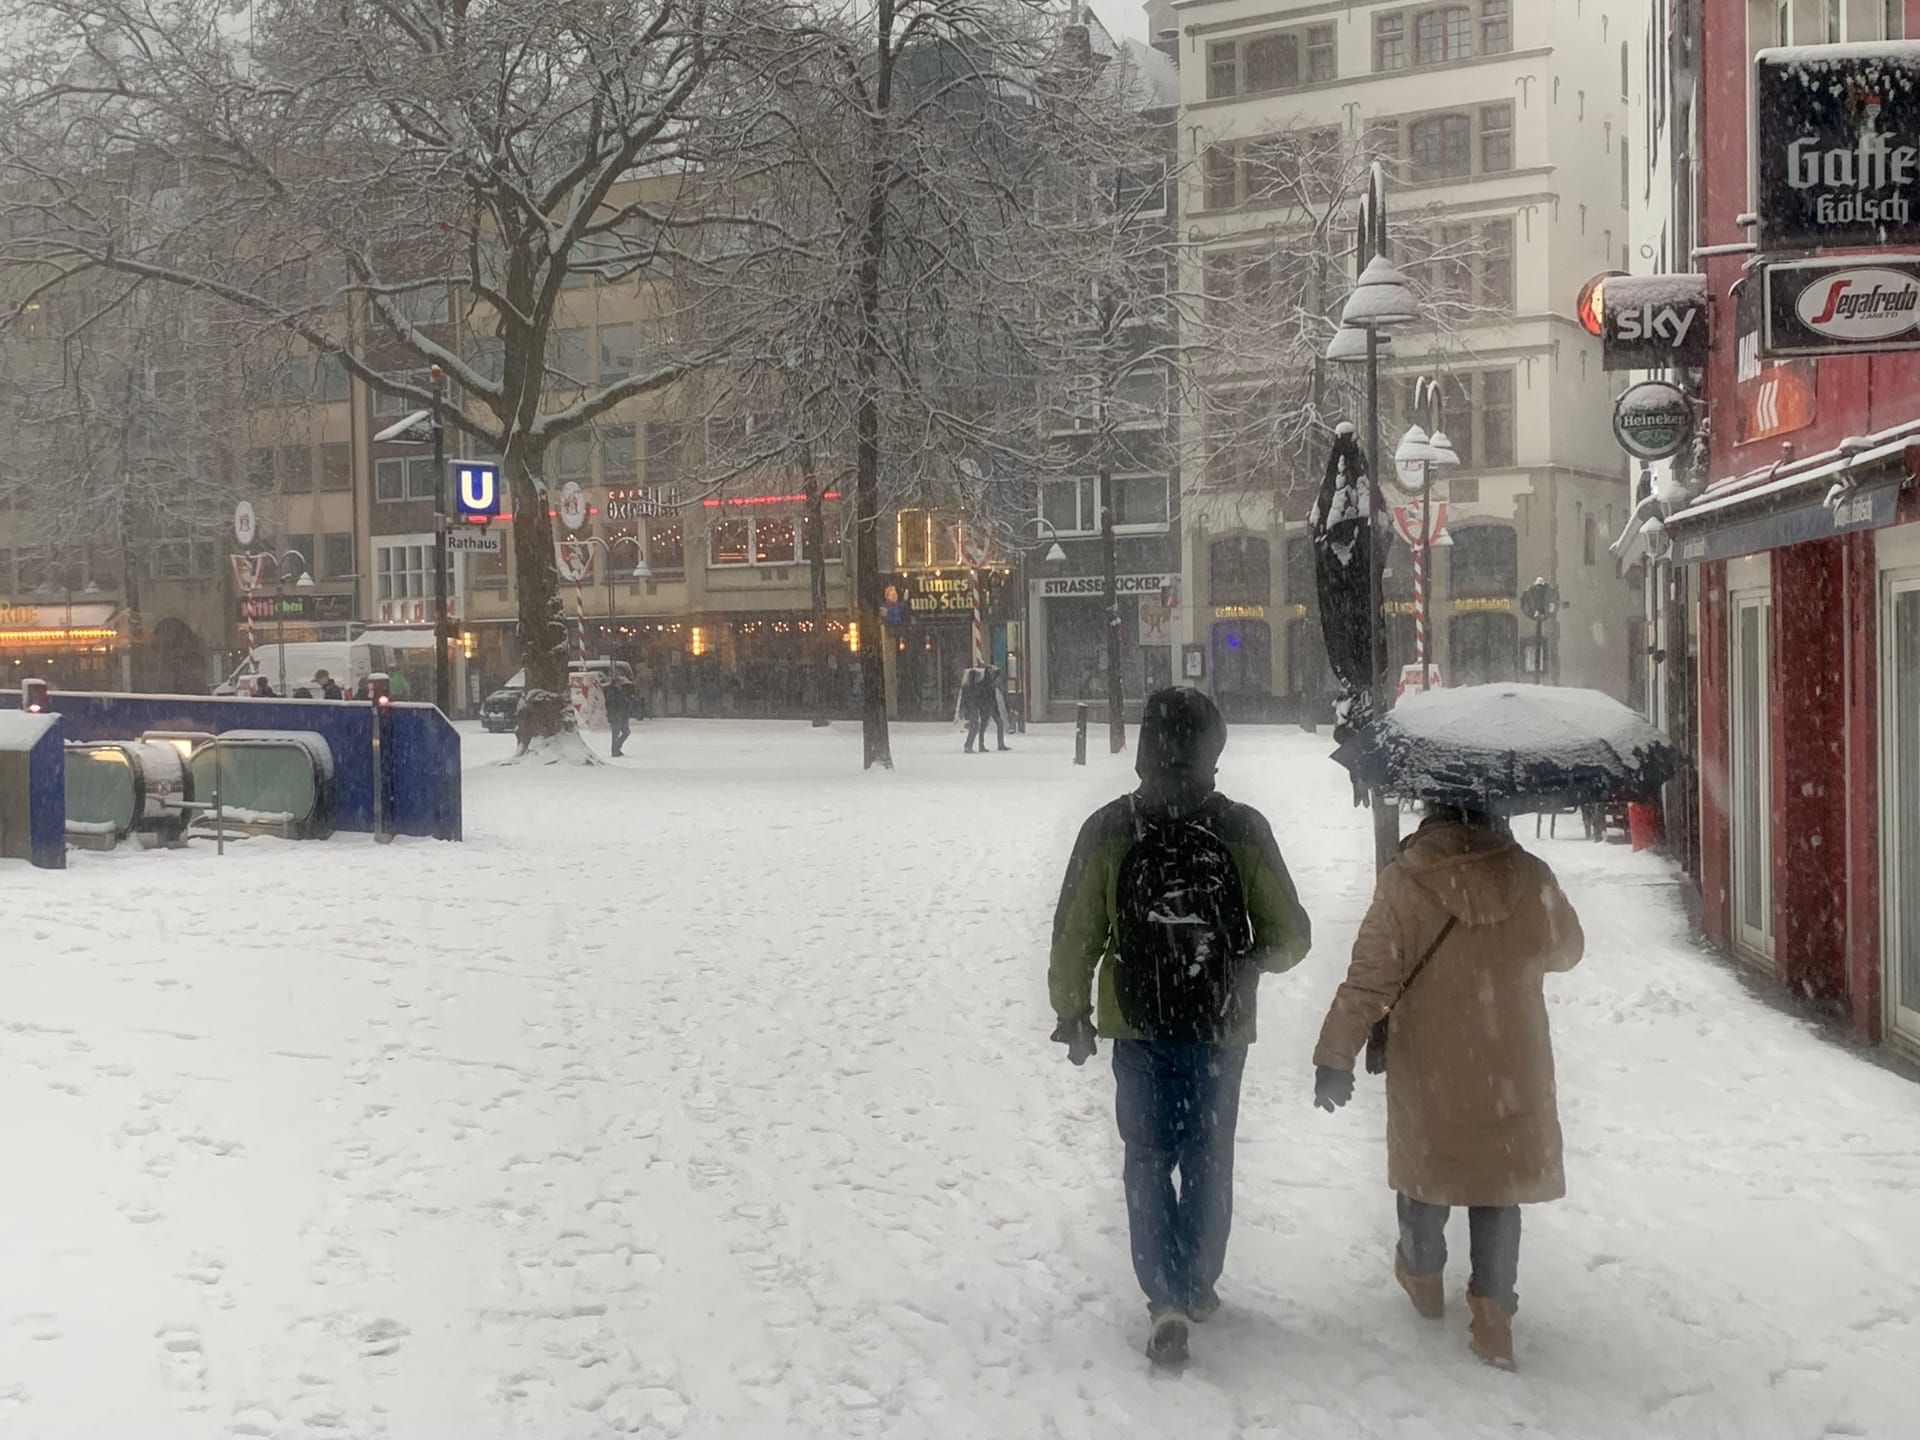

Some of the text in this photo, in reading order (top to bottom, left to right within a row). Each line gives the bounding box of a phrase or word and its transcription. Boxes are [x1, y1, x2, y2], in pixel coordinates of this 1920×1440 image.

[1787, 131, 1920, 190] Gaffe
[1811, 280, 1918, 324] Segafredo
[1616, 303, 1697, 348] sky
[1623, 413, 1688, 427] Heineken
[461, 470, 493, 509] U
[448, 536, 498, 549] Rathaus
[910, 591, 979, 611] und Schä
